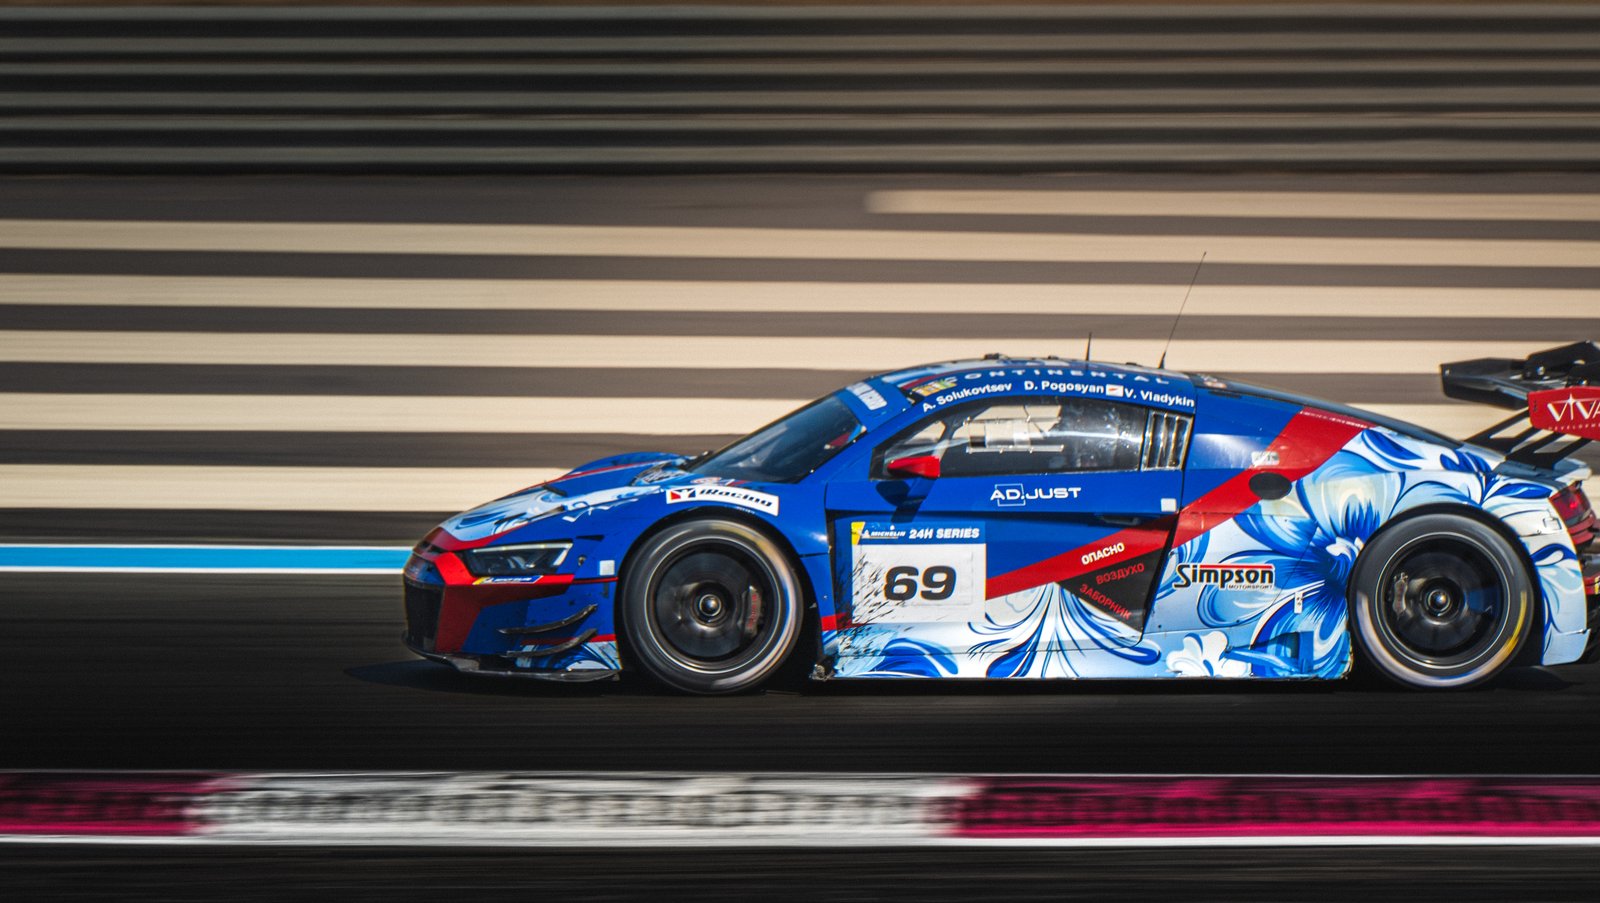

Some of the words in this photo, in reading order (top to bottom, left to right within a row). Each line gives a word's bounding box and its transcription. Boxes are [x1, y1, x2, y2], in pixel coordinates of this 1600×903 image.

[943, 368, 1170, 386] CONTINENTAL
[922, 401, 936, 413] A.
[936, 382, 1012, 405] Solukovtsev
[1024, 380, 1038, 391] D.
[1041, 380, 1104, 396] Pogosyan
[1124, 387, 1137, 399] V.
[1140, 390, 1195, 408] Vladykin
[990, 487, 1082, 500] AD.JUST
[909, 528, 933, 539] 24H
[936, 528, 980, 539] SERIES
[1081, 542, 1125, 565] ОПАСНО
[884, 566, 957, 600] 69
[1096, 563, 1145, 585] ВОЗДУХО
[1173, 564, 1274, 588] Simpson
[1080, 584, 1132, 620] ЗАБОРНИК
